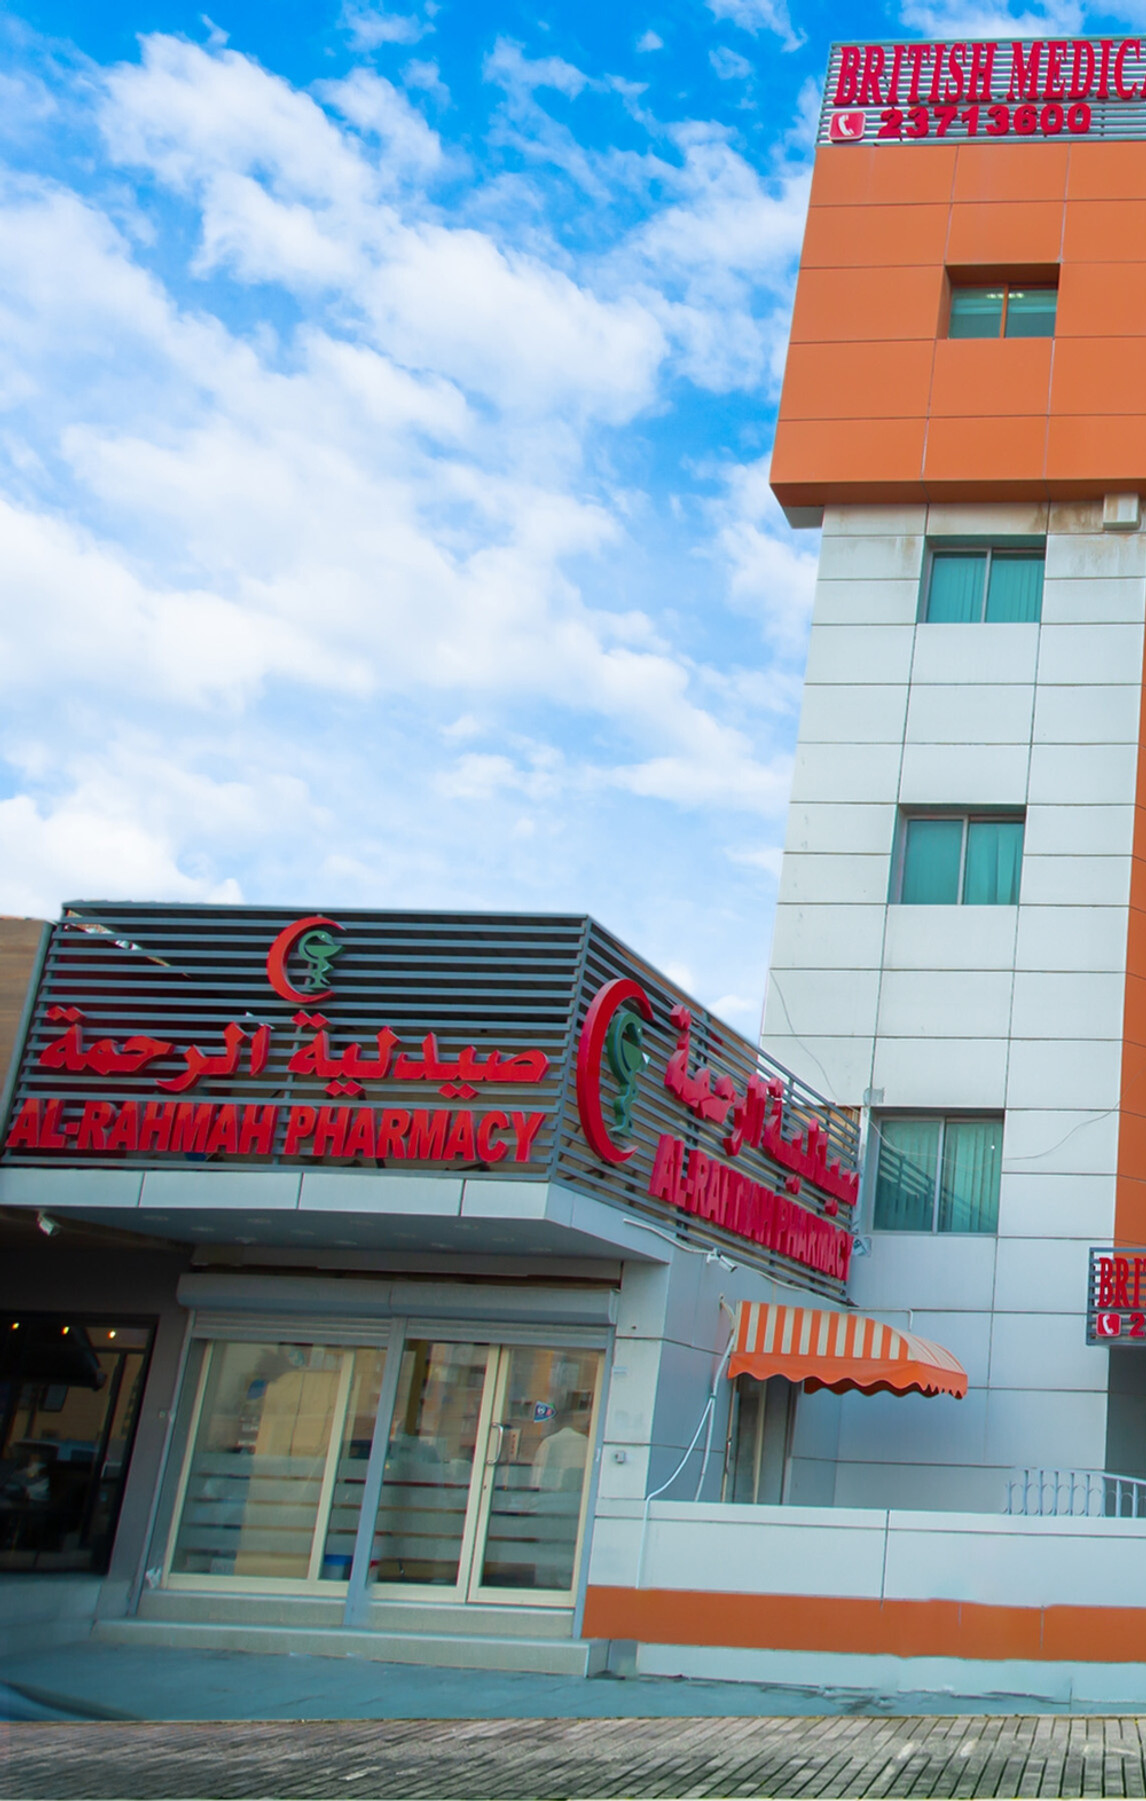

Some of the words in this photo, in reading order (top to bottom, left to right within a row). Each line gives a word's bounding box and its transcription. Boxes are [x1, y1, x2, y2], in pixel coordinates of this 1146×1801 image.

[833, 43, 998, 105] BRITISH
[877, 103, 1092, 138] 23713600
[37, 1005, 275, 1093] الرحمة
[288, 1009, 552, 1100] صيدلية
[6, 1098, 277, 1155] AL-RAHMAH
[283, 1107, 547, 1162] PHARMACY
